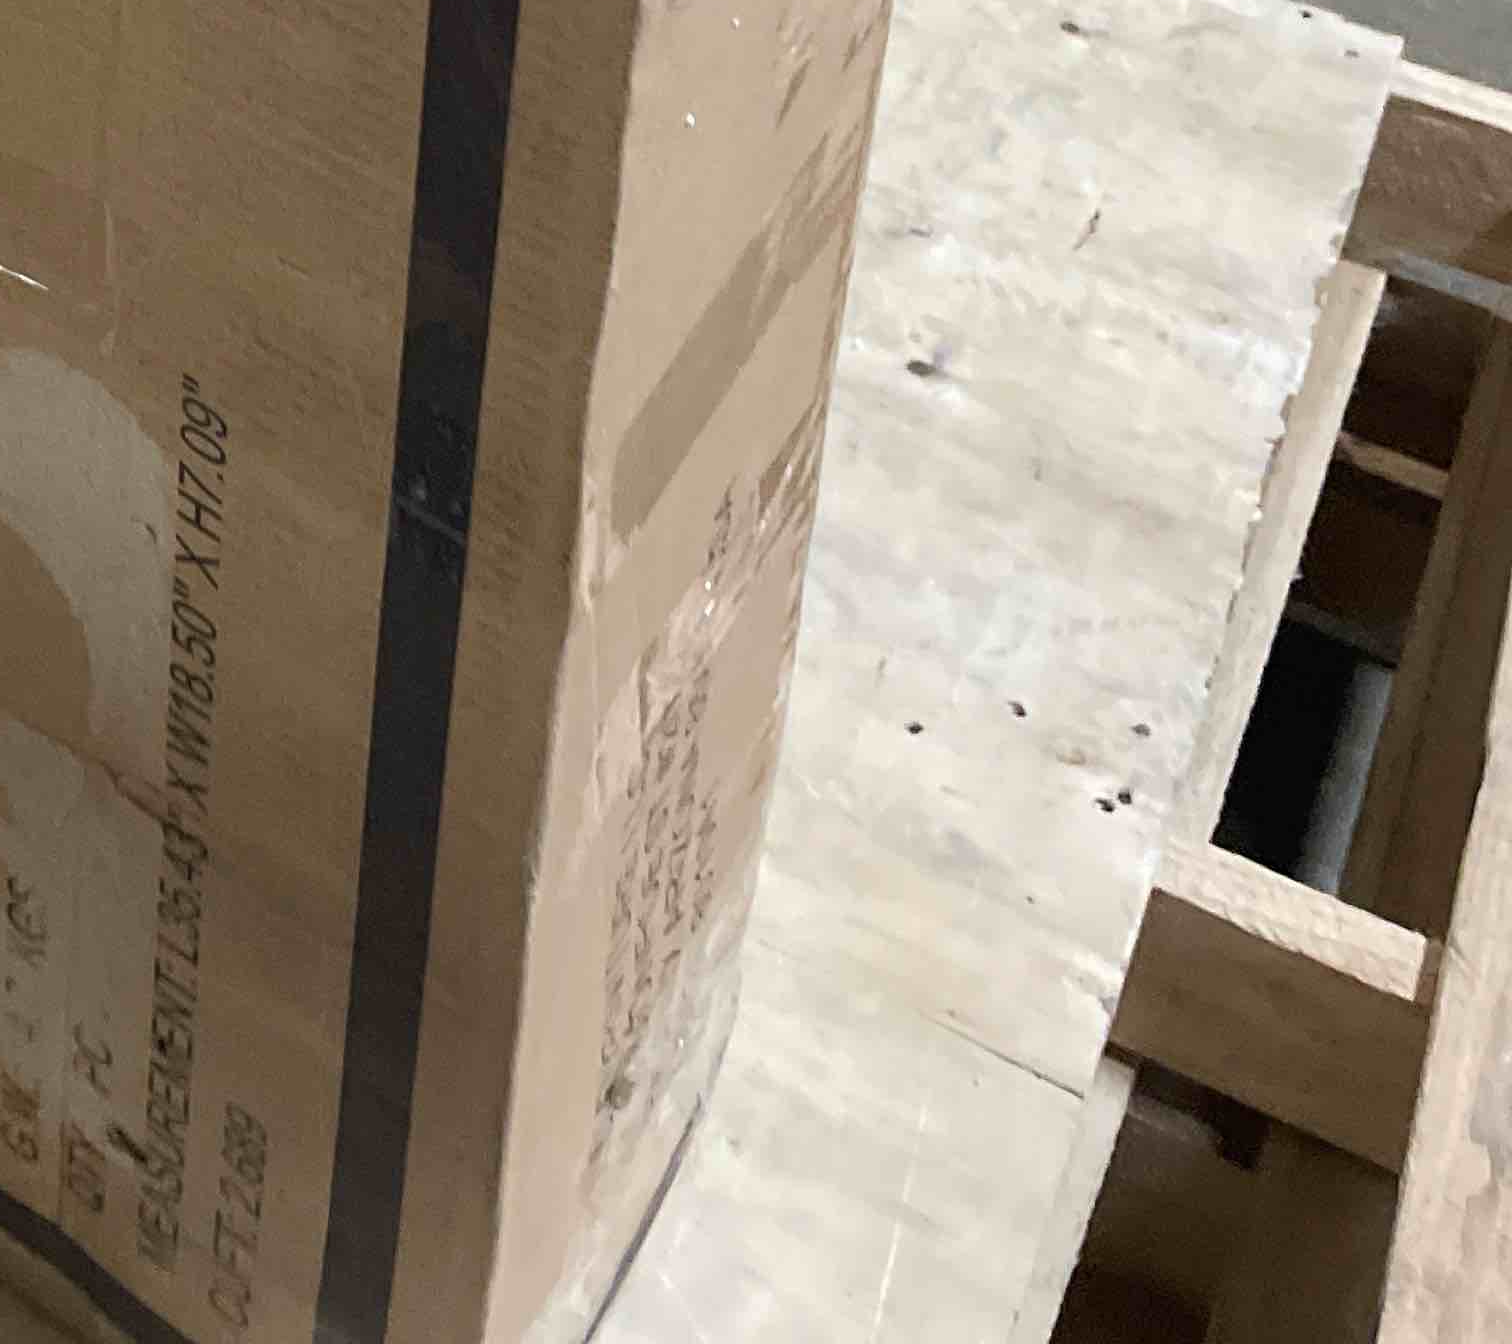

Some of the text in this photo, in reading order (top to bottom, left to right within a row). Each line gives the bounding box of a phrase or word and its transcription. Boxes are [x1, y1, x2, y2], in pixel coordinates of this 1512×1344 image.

[175, 368, 229, 545] H7.09"
[172, 532, 223, 590] X
[164, 573, 219, 765] W18.50"
[162, 761, 211, 809] X
